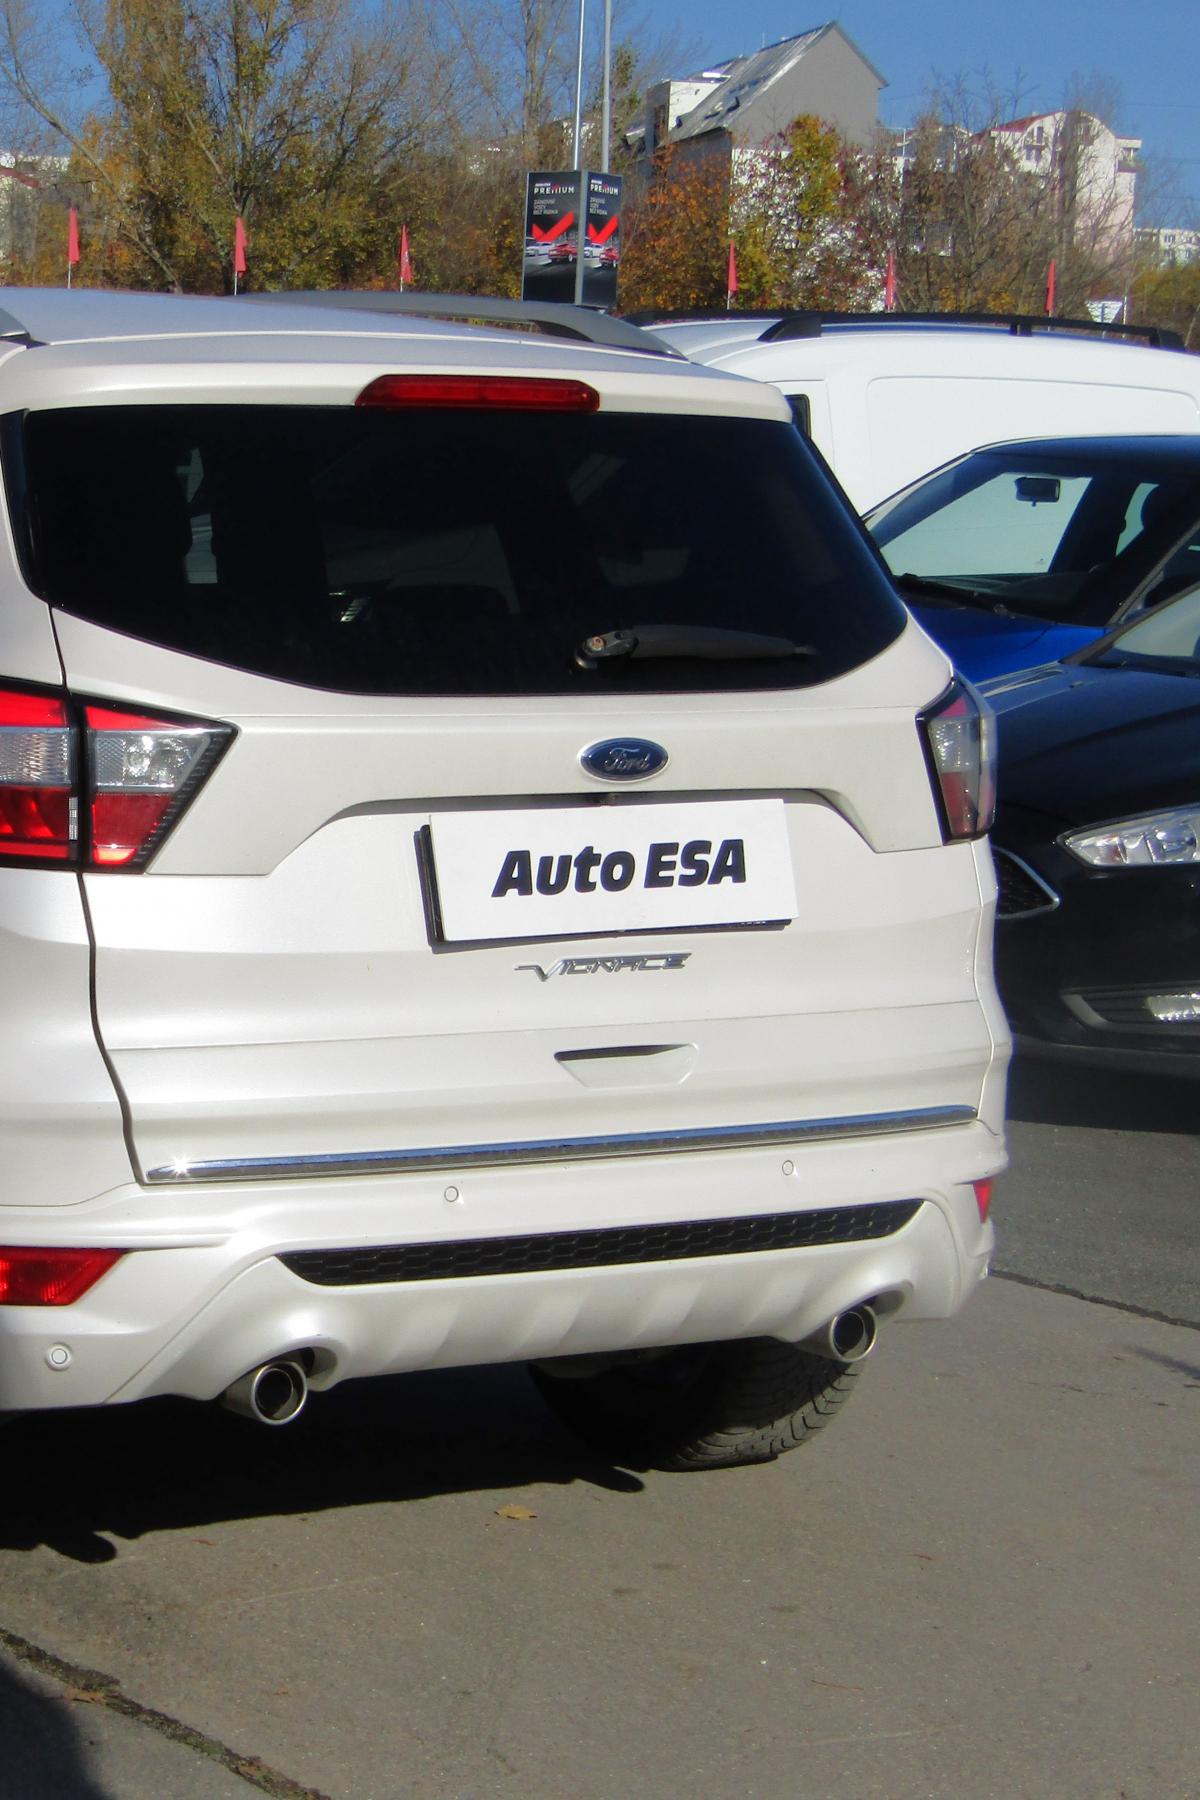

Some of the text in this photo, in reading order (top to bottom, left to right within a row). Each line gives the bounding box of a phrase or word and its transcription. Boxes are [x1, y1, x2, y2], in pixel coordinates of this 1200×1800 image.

[534, 184, 575, 195] PREMIUM
[604, 747, 651, 771] Ford
[491, 839, 747, 898] Auto ESA
